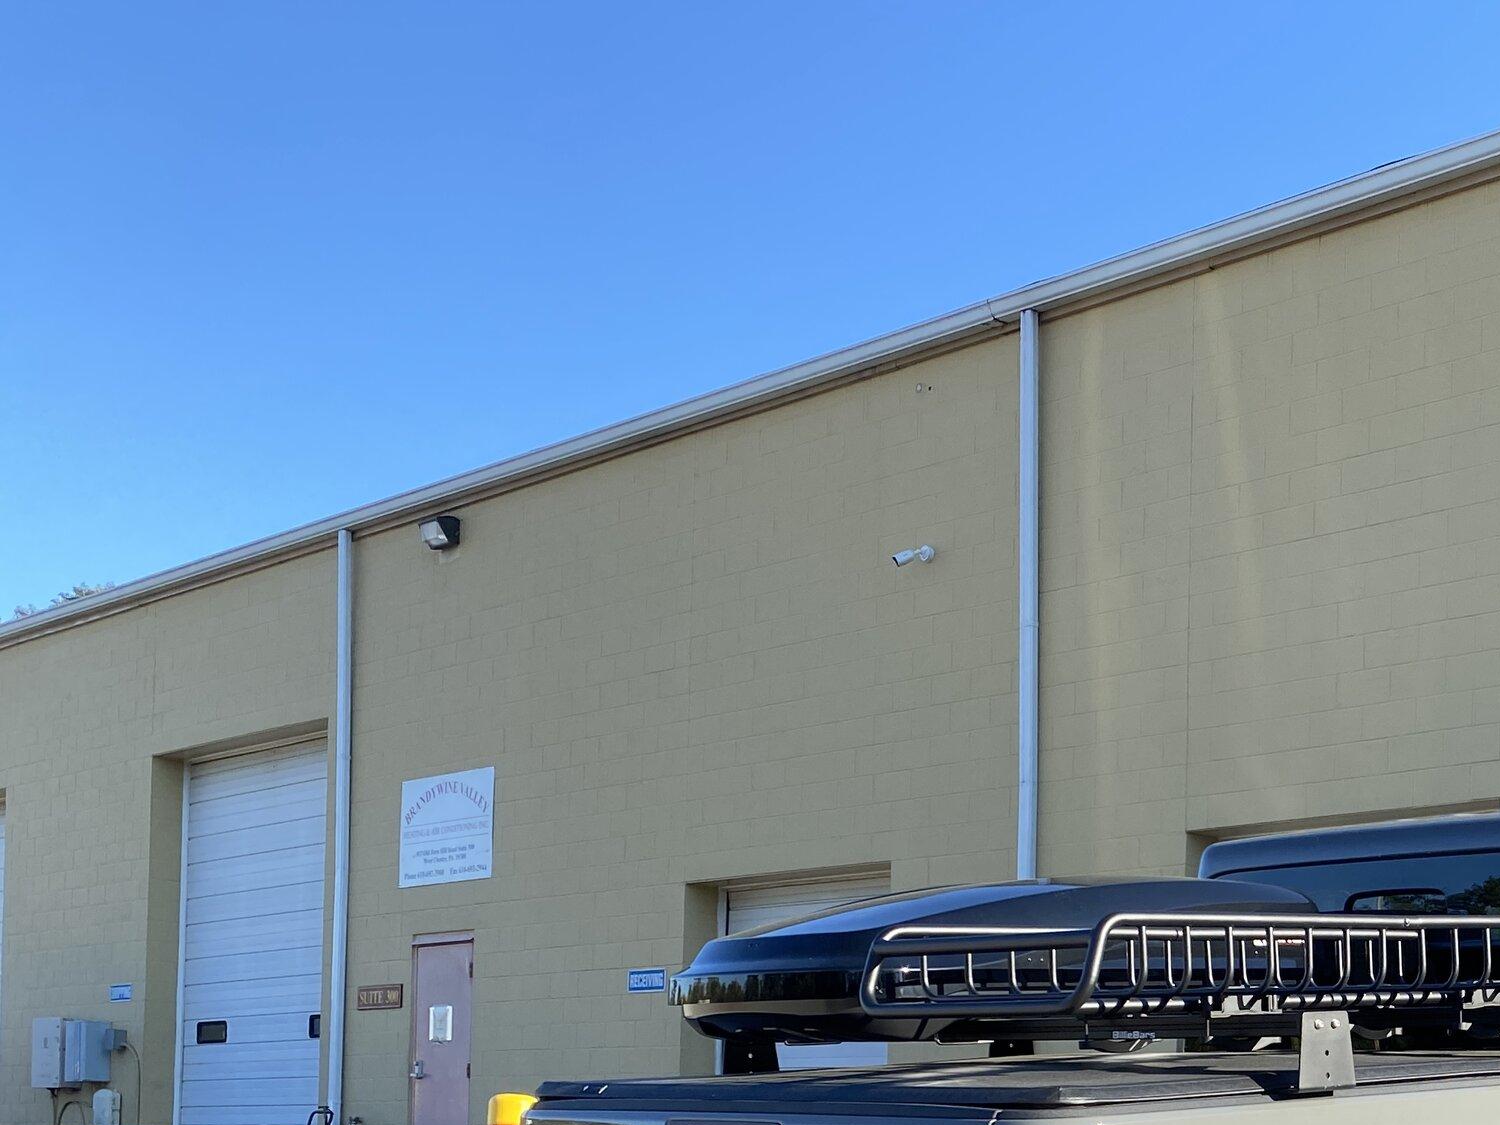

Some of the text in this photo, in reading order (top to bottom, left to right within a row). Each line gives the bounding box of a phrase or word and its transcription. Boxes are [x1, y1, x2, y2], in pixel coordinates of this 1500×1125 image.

[405, 781, 489, 825] BRANDYWINE VALLEY
[359, 990, 384, 1005] SUITE
